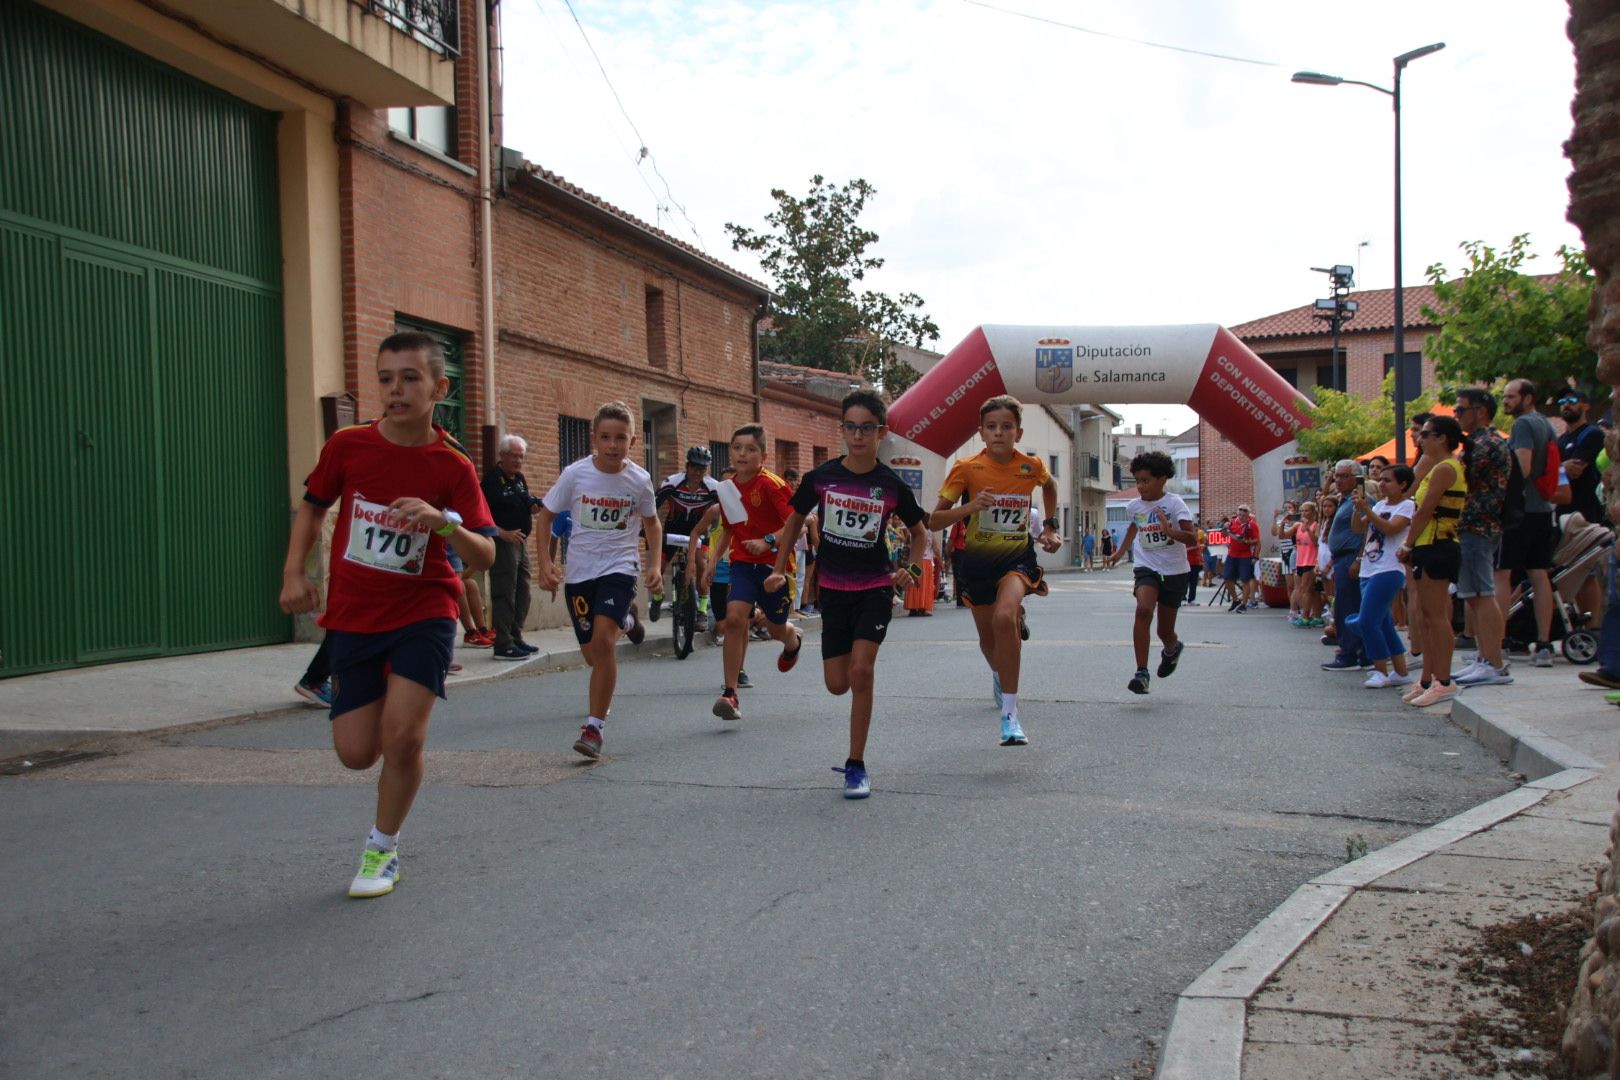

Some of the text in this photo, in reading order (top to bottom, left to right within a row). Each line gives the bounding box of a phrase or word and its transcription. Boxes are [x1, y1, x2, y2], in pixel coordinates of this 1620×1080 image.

[1076, 344, 1151, 360] Diputación
[1075, 370, 1166, 383] de Salamanca
[1217, 356, 1242, 379] CON
[905, 360, 995, 440] CON EL DEPORTE
[1210, 371, 1284, 437] DEPORTISTAS
[591, 507, 620, 522] 160
[836, 509, 869, 530] 159
[991, 509, 1021, 524] 172
[364, 526, 412, 557] 170
[1145, 532, 1168, 544] 185
[572, 595, 589, 616] 10
